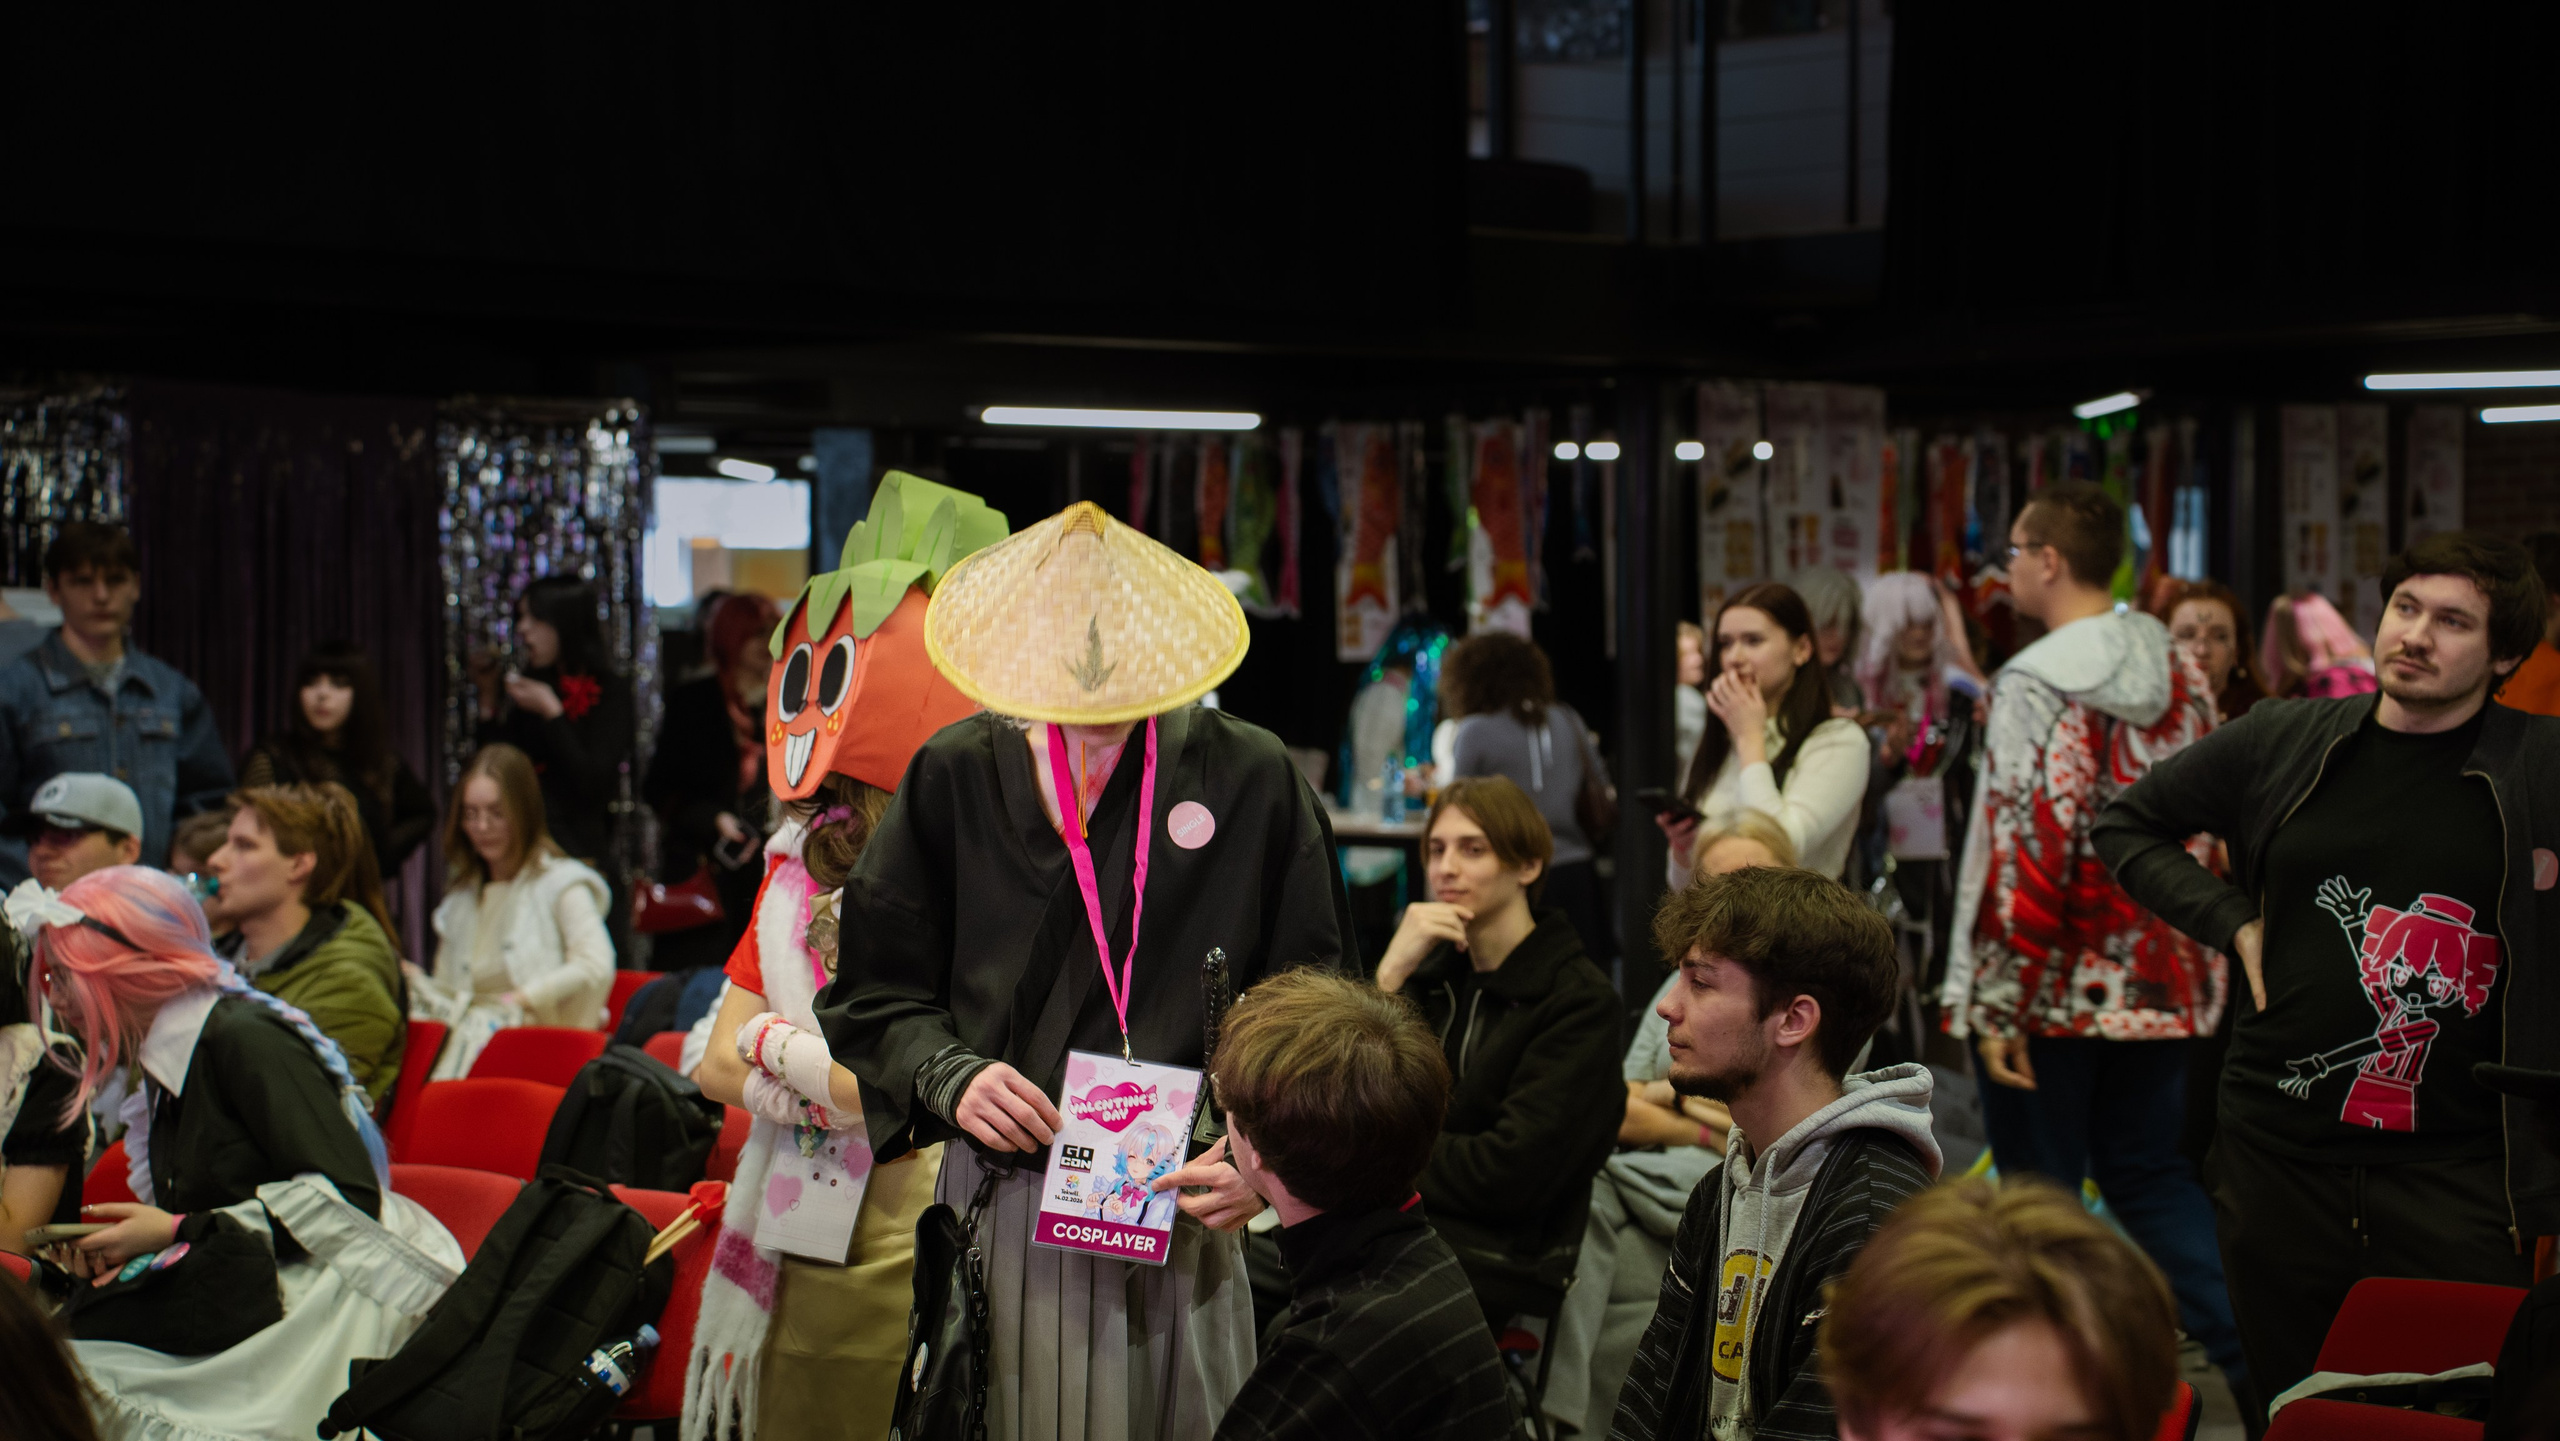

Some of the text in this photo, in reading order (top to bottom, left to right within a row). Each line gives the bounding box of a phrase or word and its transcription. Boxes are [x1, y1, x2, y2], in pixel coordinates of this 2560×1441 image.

[1176, 813, 1207, 838] SINGLE
[1101, 1108, 1129, 1123] DAY
[1062, 1145, 1094, 1159] GO
[1060, 1157, 1091, 1169] CON
[1054, 1195, 1083, 1203] 14.02.2026
[1053, 1222, 1156, 1252] COSPLAYER
